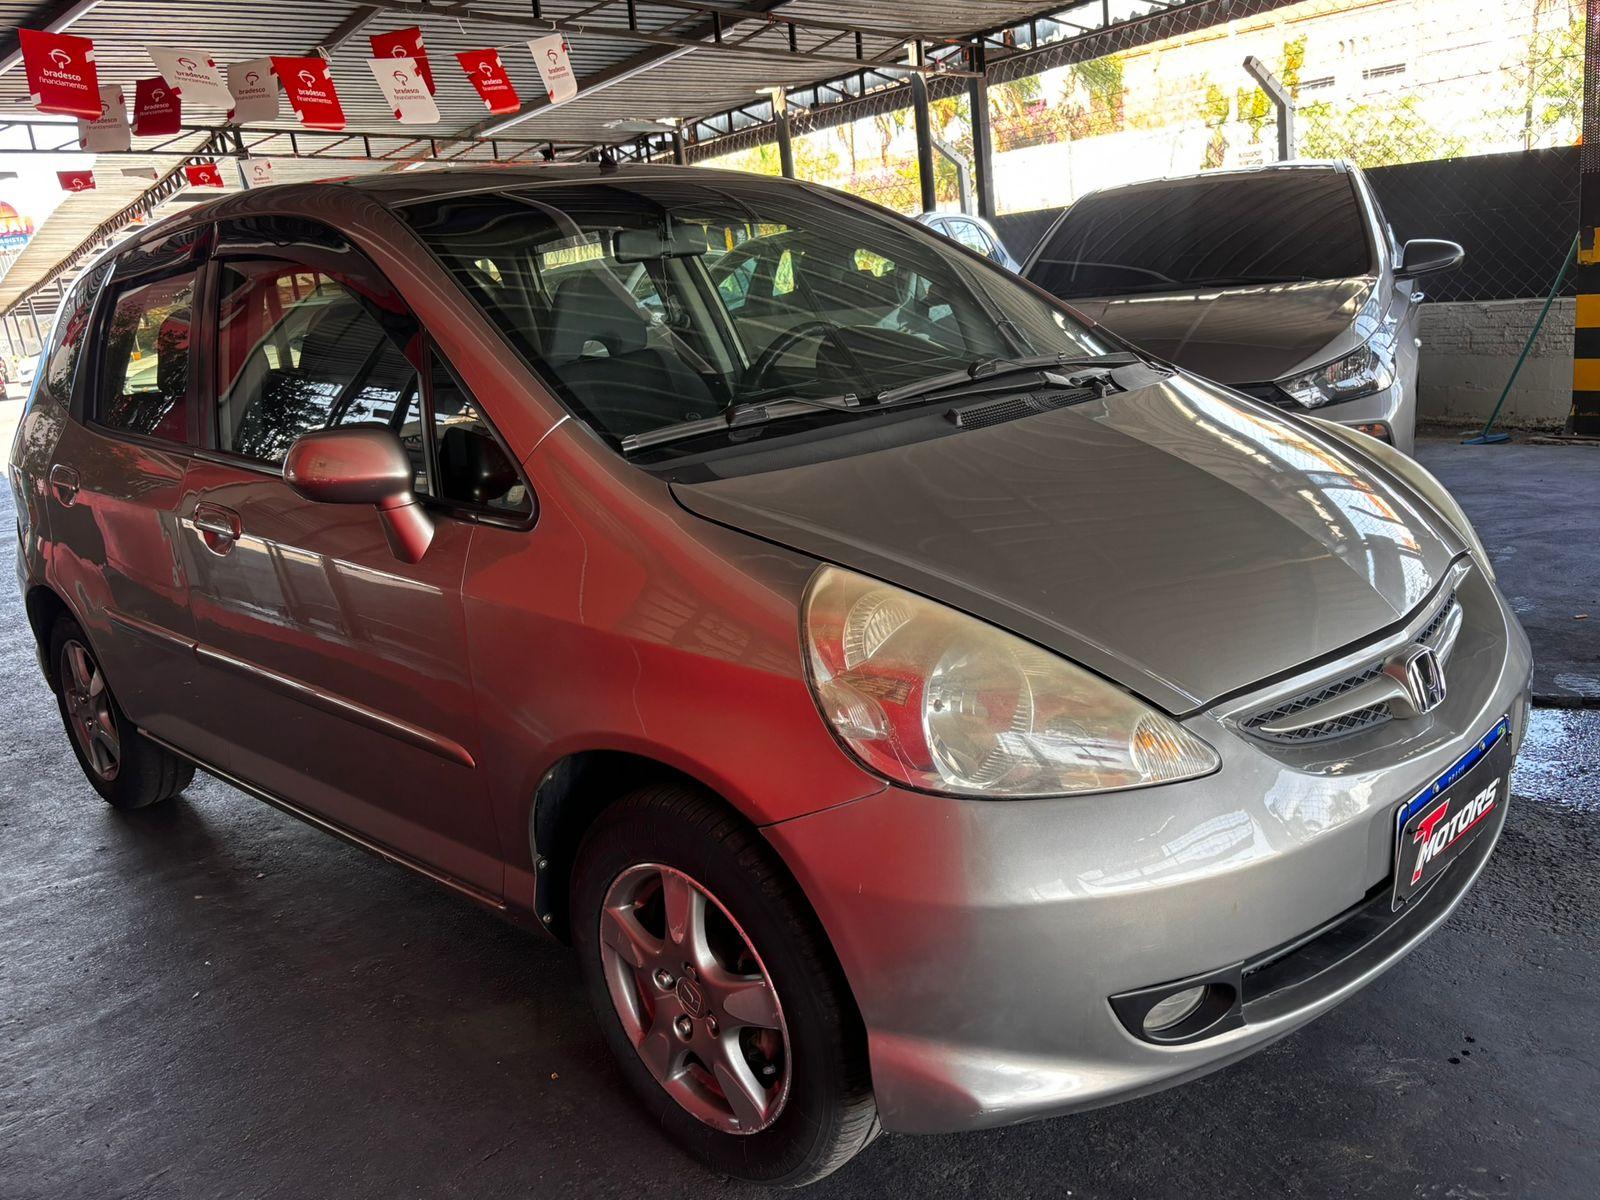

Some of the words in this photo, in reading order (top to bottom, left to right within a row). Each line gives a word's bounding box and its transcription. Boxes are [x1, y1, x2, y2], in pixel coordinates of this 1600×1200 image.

[43, 68, 82, 81] bradesco
[39, 76, 88, 91] financiamentos
[239, 87, 266, 95] bradesco
[297, 88, 327, 97] bradesco
[143, 102, 170, 111] bradesco
[1420, 777, 1500, 865] MOTORS
